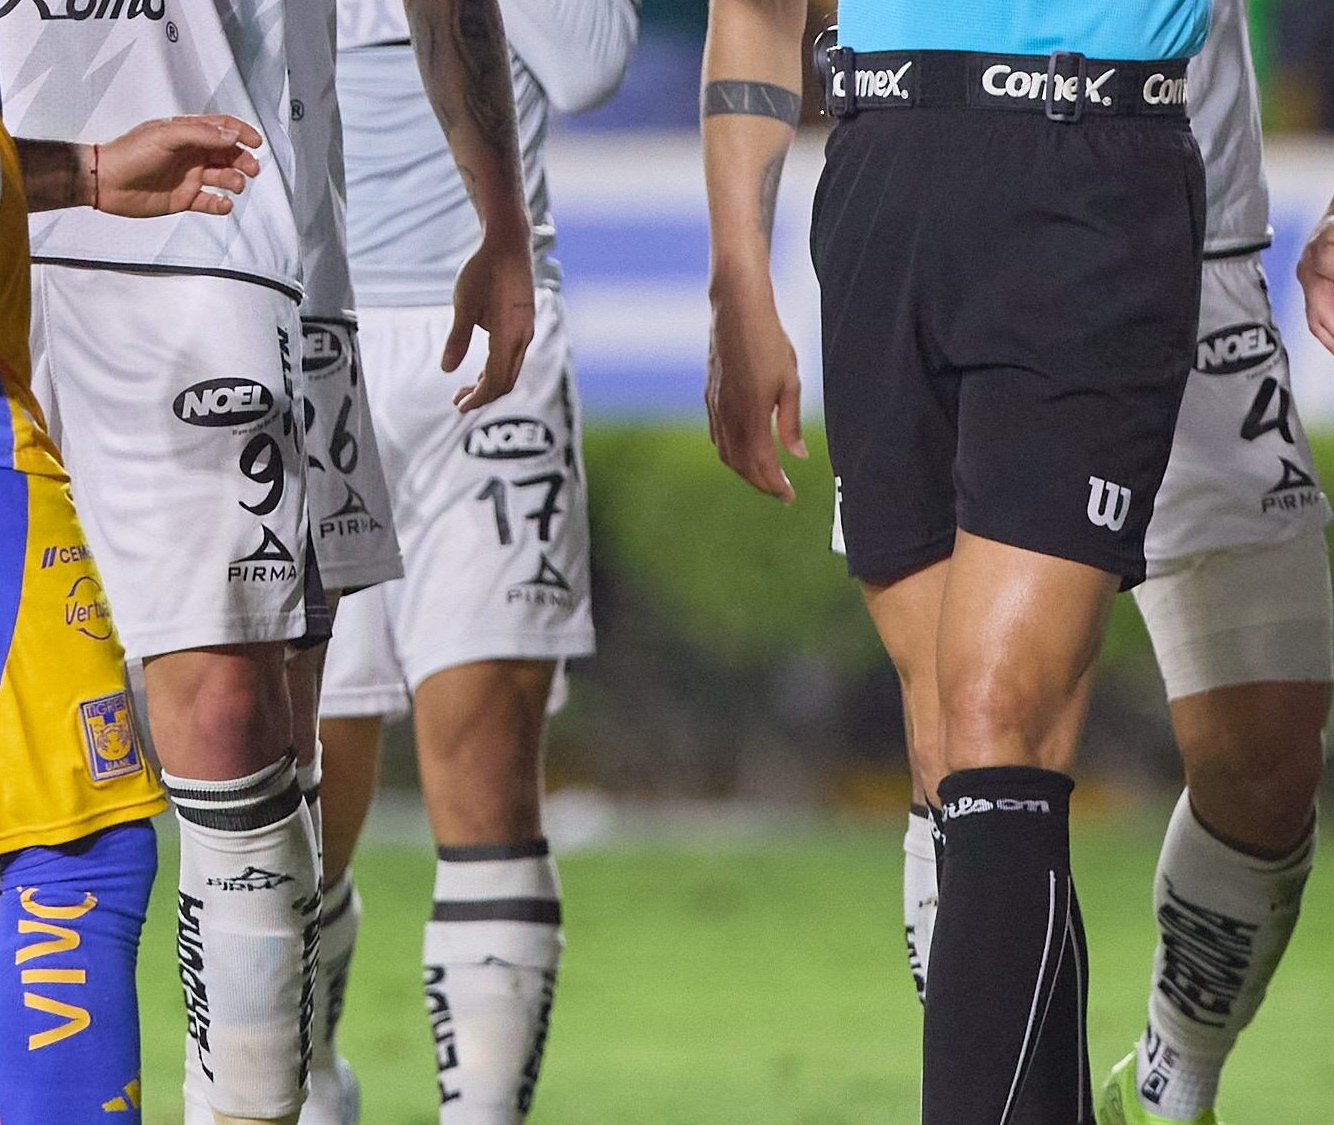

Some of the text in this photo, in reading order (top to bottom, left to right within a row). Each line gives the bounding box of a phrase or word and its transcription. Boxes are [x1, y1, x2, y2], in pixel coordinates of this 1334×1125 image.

[1196, 327, 1276, 370] NOEL
[181, 384, 269, 419] NOEL
[1239, 375, 1296, 445] 4
[468, 423, 550, 456] NOEL
[238, 431, 286, 517] 9
[476, 471, 566, 546] 17
[227, 563, 299, 583] PIRMA
[86, 699, 124, 718] TIGRES
